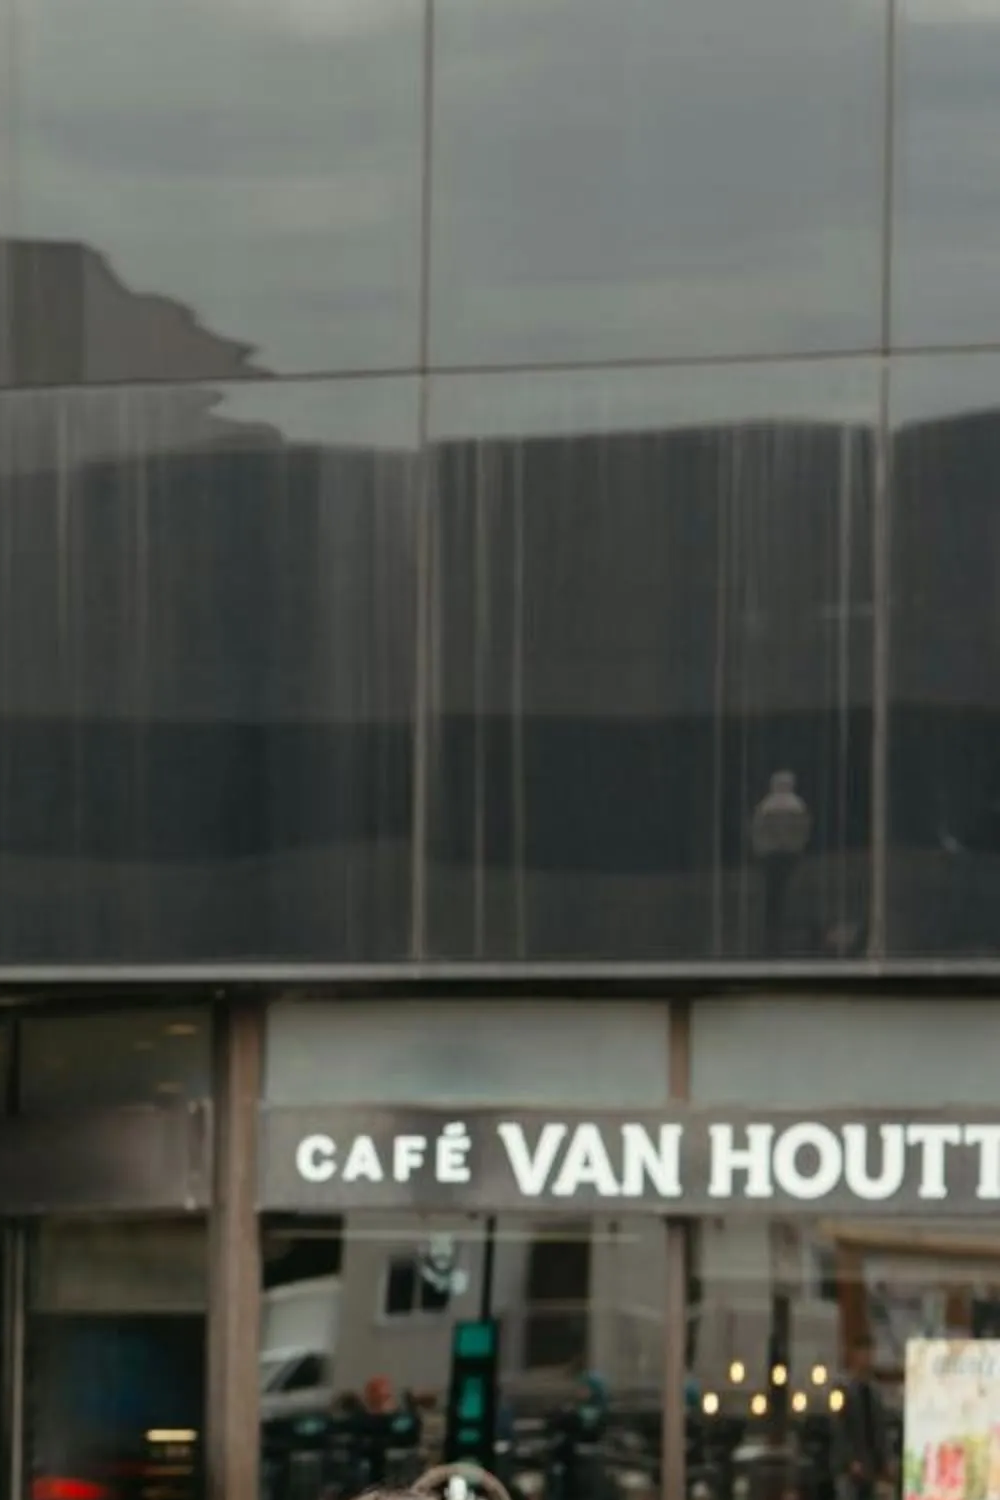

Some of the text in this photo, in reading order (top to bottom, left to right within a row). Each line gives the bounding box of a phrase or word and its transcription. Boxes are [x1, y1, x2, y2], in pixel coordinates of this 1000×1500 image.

[296, 1121, 1000, 1200] CAFÉ VAN HOUTT
